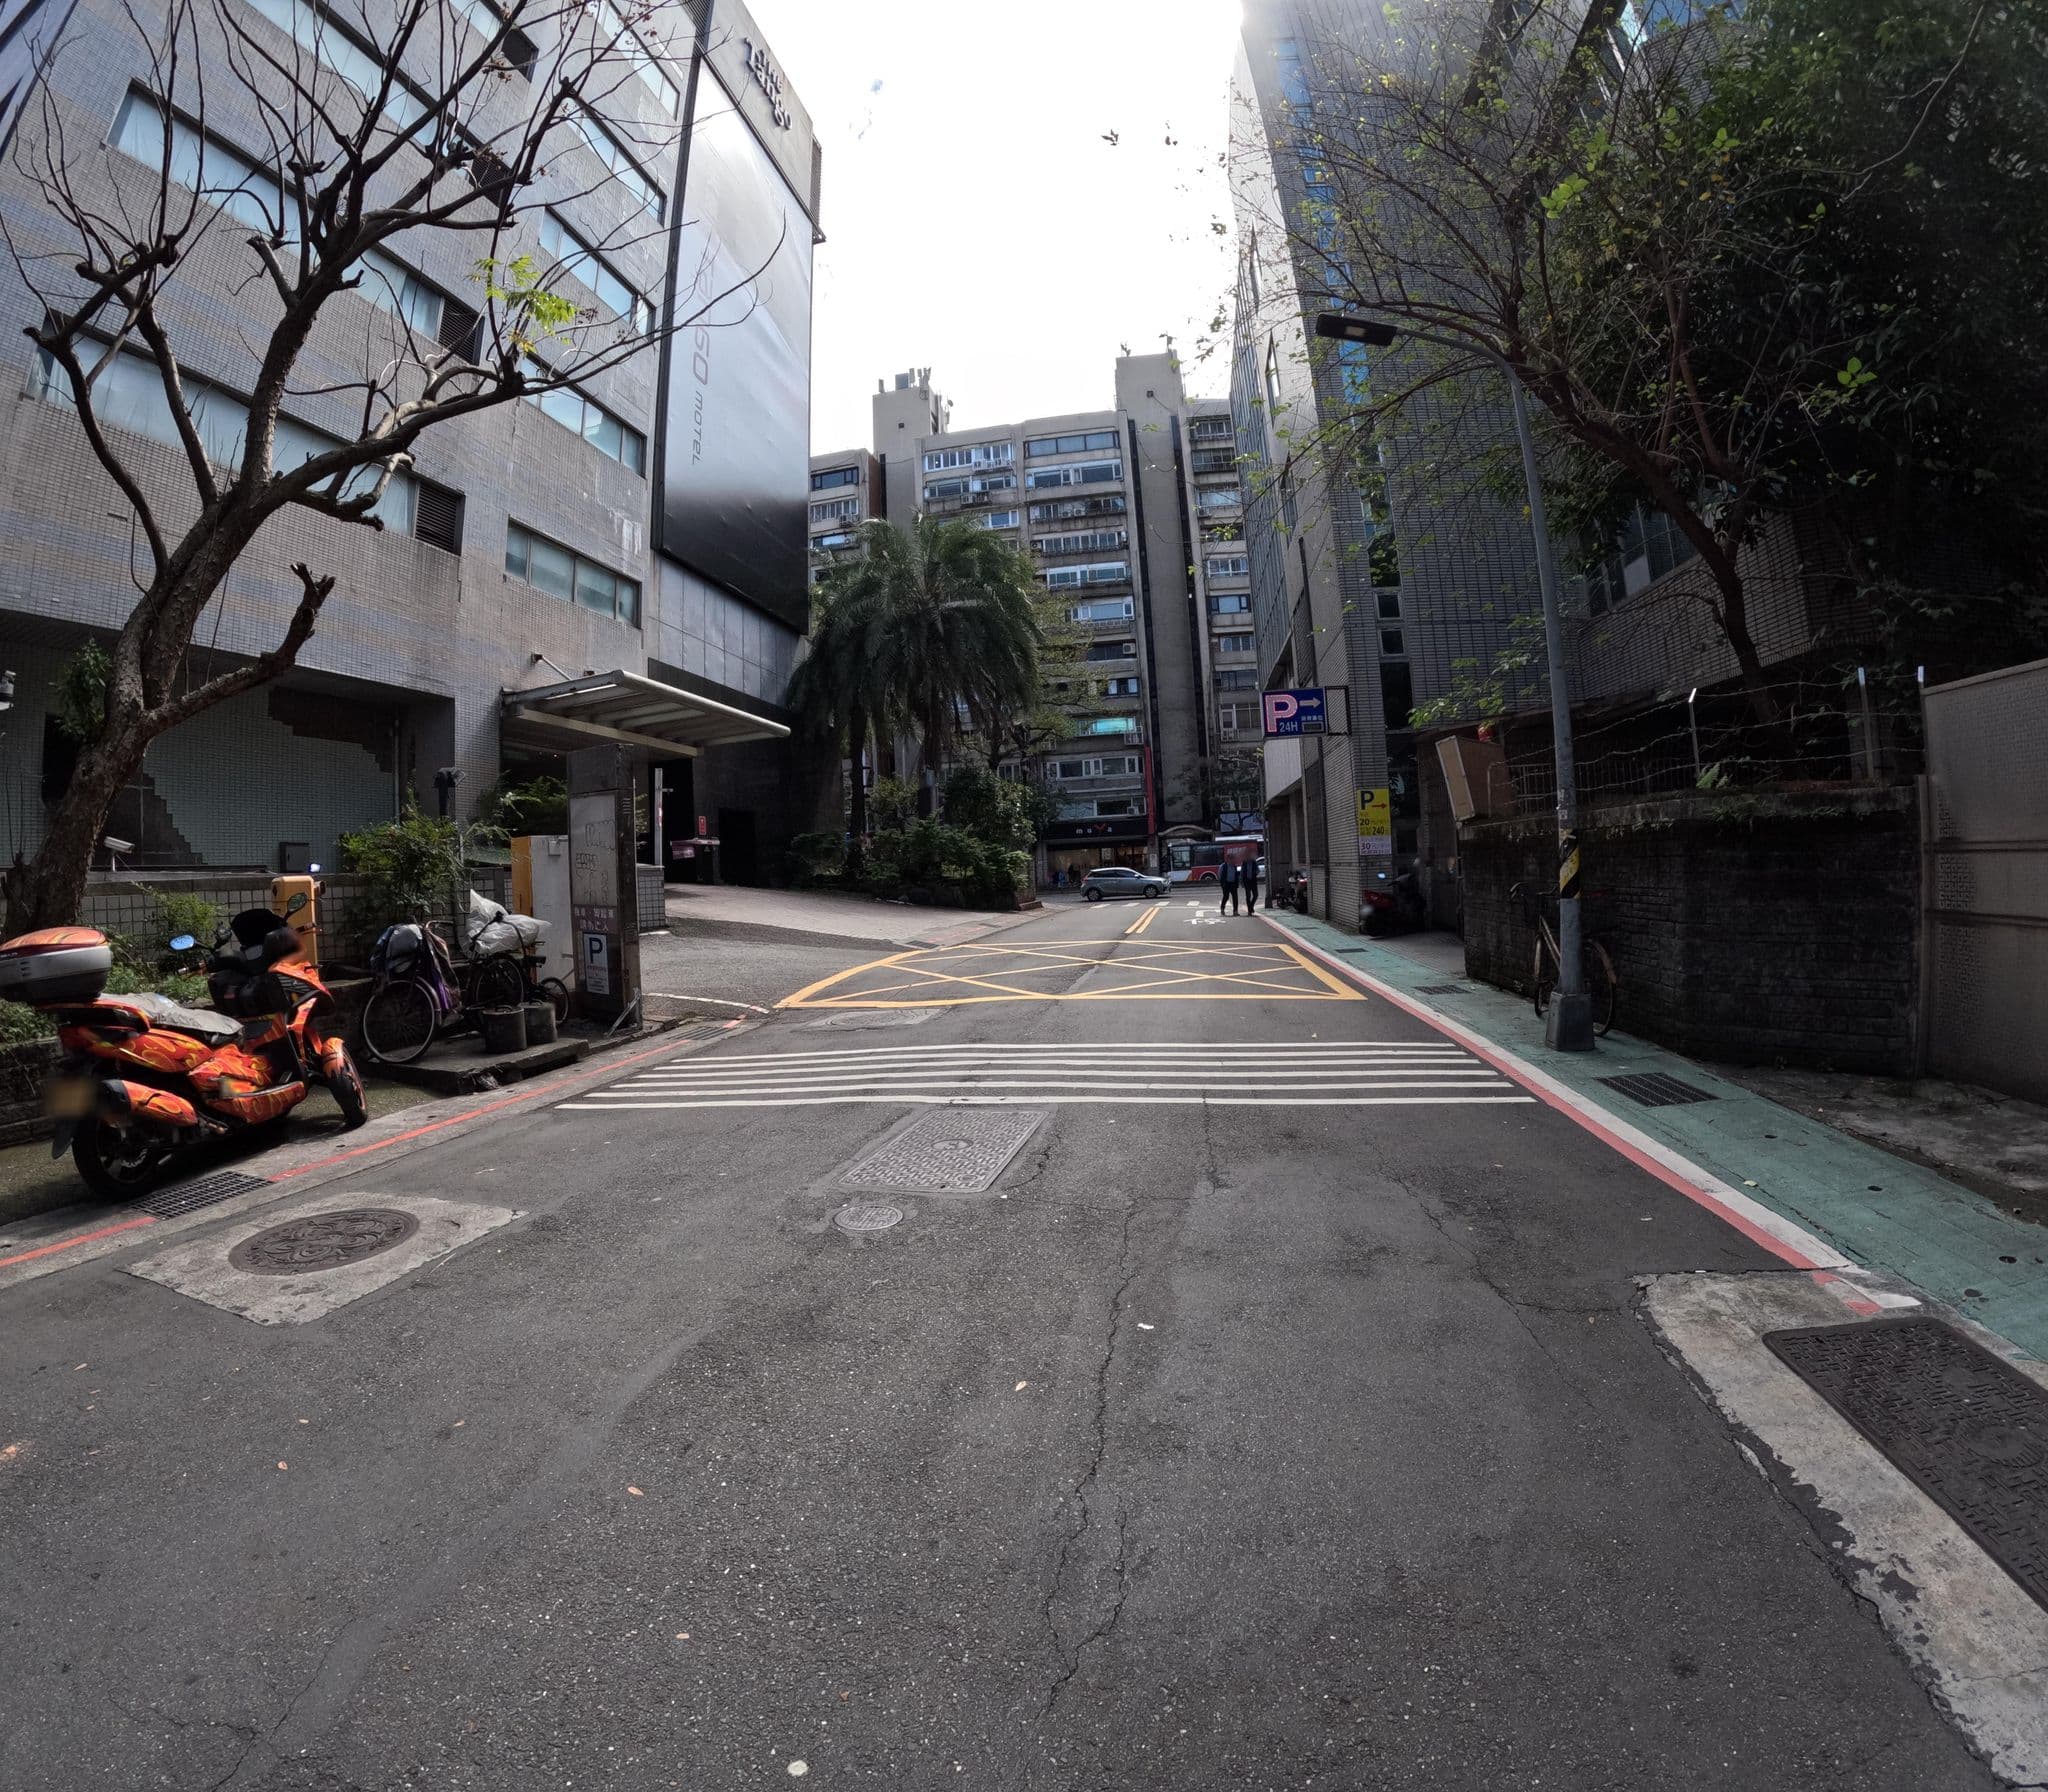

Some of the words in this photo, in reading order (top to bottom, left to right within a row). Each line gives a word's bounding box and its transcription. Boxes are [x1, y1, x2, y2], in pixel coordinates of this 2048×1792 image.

[744, 37, 792, 130] Tango
[1265, 694, 1298, 732] P
[1280, 721, 1299, 732] 24H
[1361, 790, 1374, 810] P
[589, 937, 604, 964] P
